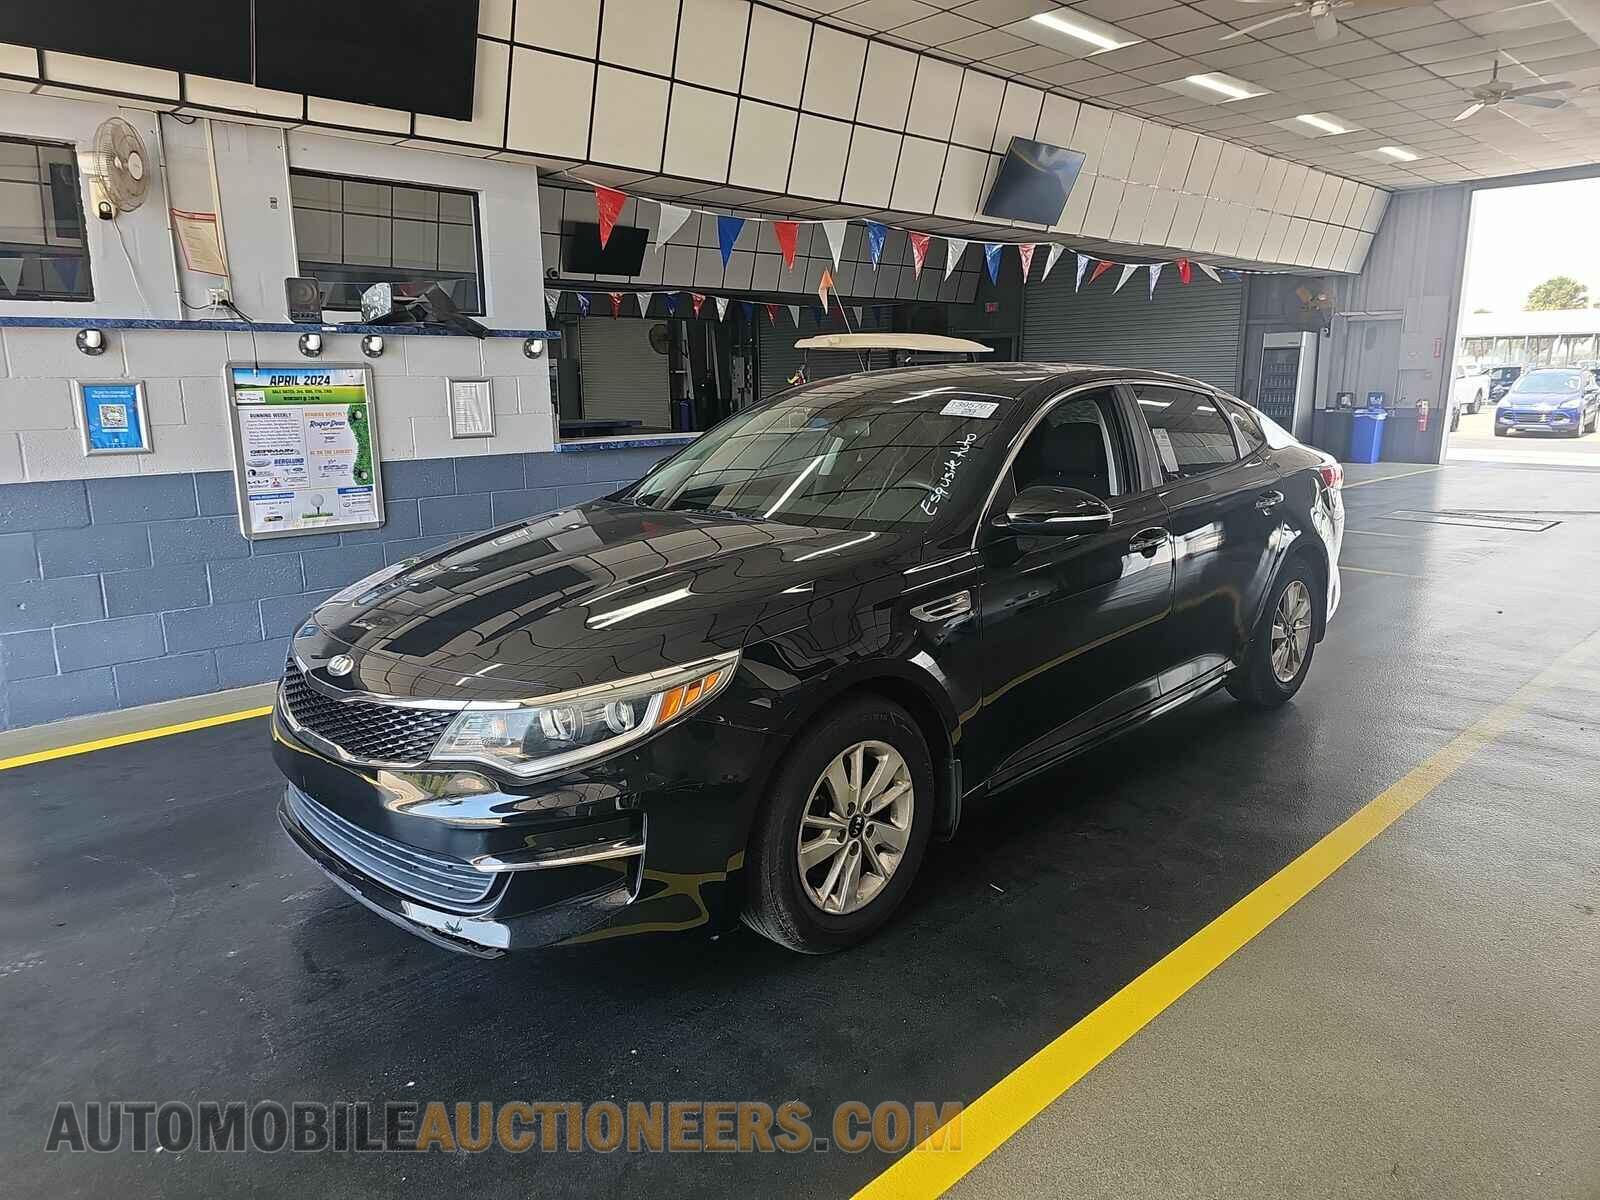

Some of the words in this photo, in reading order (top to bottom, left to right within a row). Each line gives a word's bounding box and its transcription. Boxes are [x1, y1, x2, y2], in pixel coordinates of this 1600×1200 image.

[270, 375, 299, 386] APRIL
[304, 375, 331, 386] 2024
[950, 433, 977, 458] Auto
